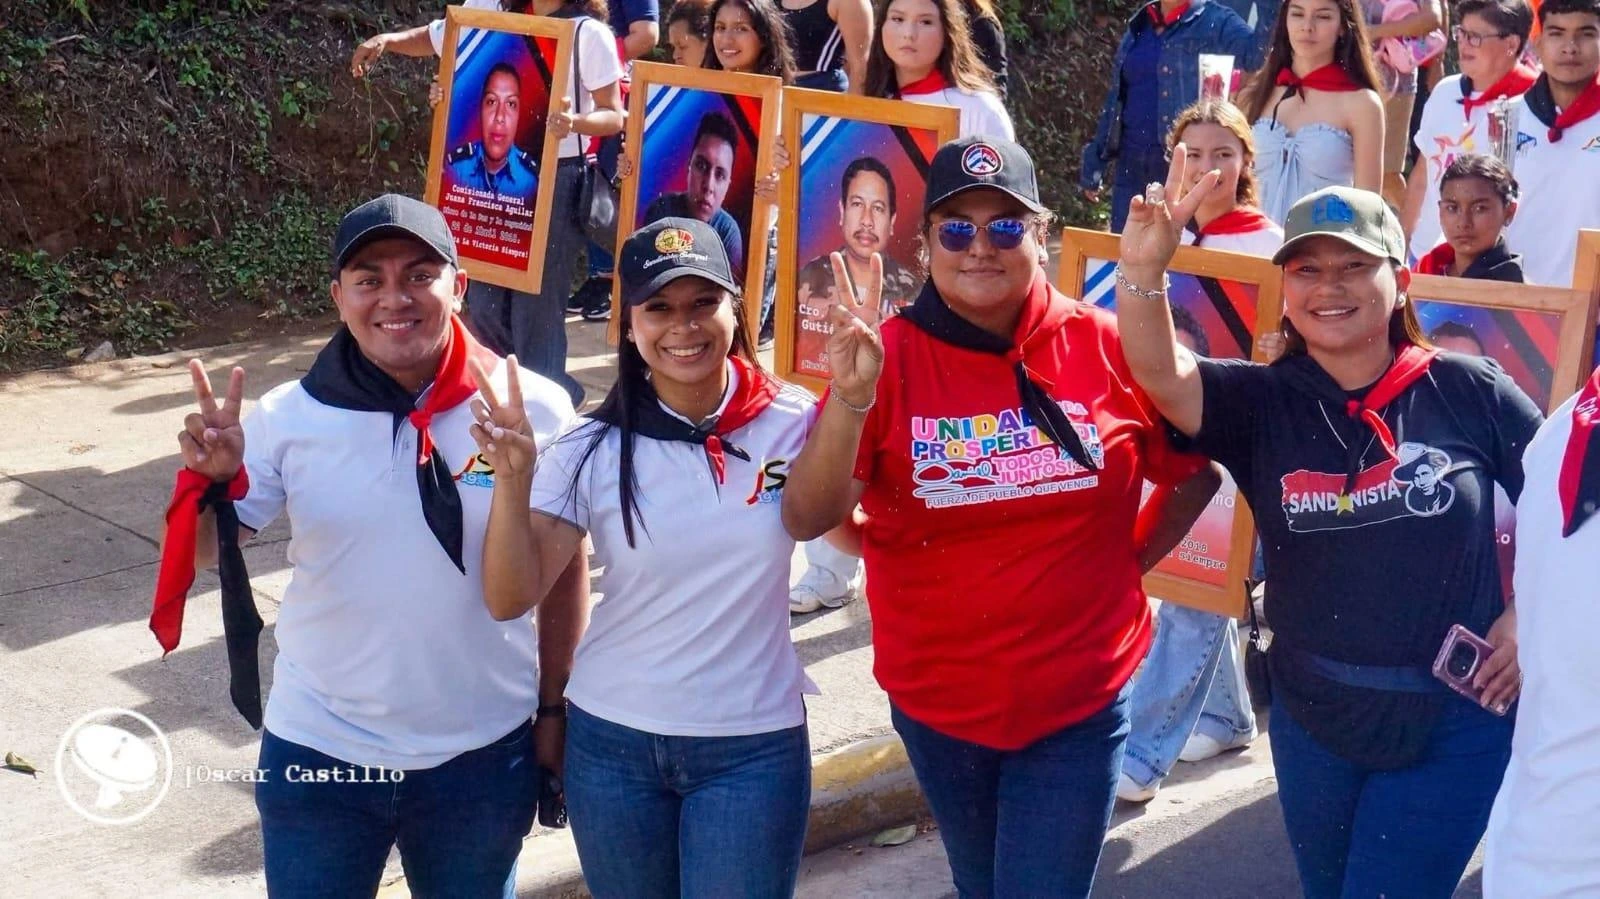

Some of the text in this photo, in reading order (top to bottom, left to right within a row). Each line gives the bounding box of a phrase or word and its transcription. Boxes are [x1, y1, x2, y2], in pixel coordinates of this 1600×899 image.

[445, 193, 534, 217] Juana Francisca Aguilar
[452, 184, 525, 205] Comisionada General
[472, 240, 499, 253] Victoria
[799, 304, 825, 318] Cro.
[801, 319, 834, 335] Gutié
[992, 447, 1056, 471] TODOS
[997, 460, 1075, 485] JUNTOS!
[926, 477, 1098, 509] FUERZA DE PUEBLO QUE VENCE!
[1289, 479, 1402, 514] SANDNISTA
[1181, 538, 1208, 553] 2018
[1179, 550, 1227, 570] siempre
